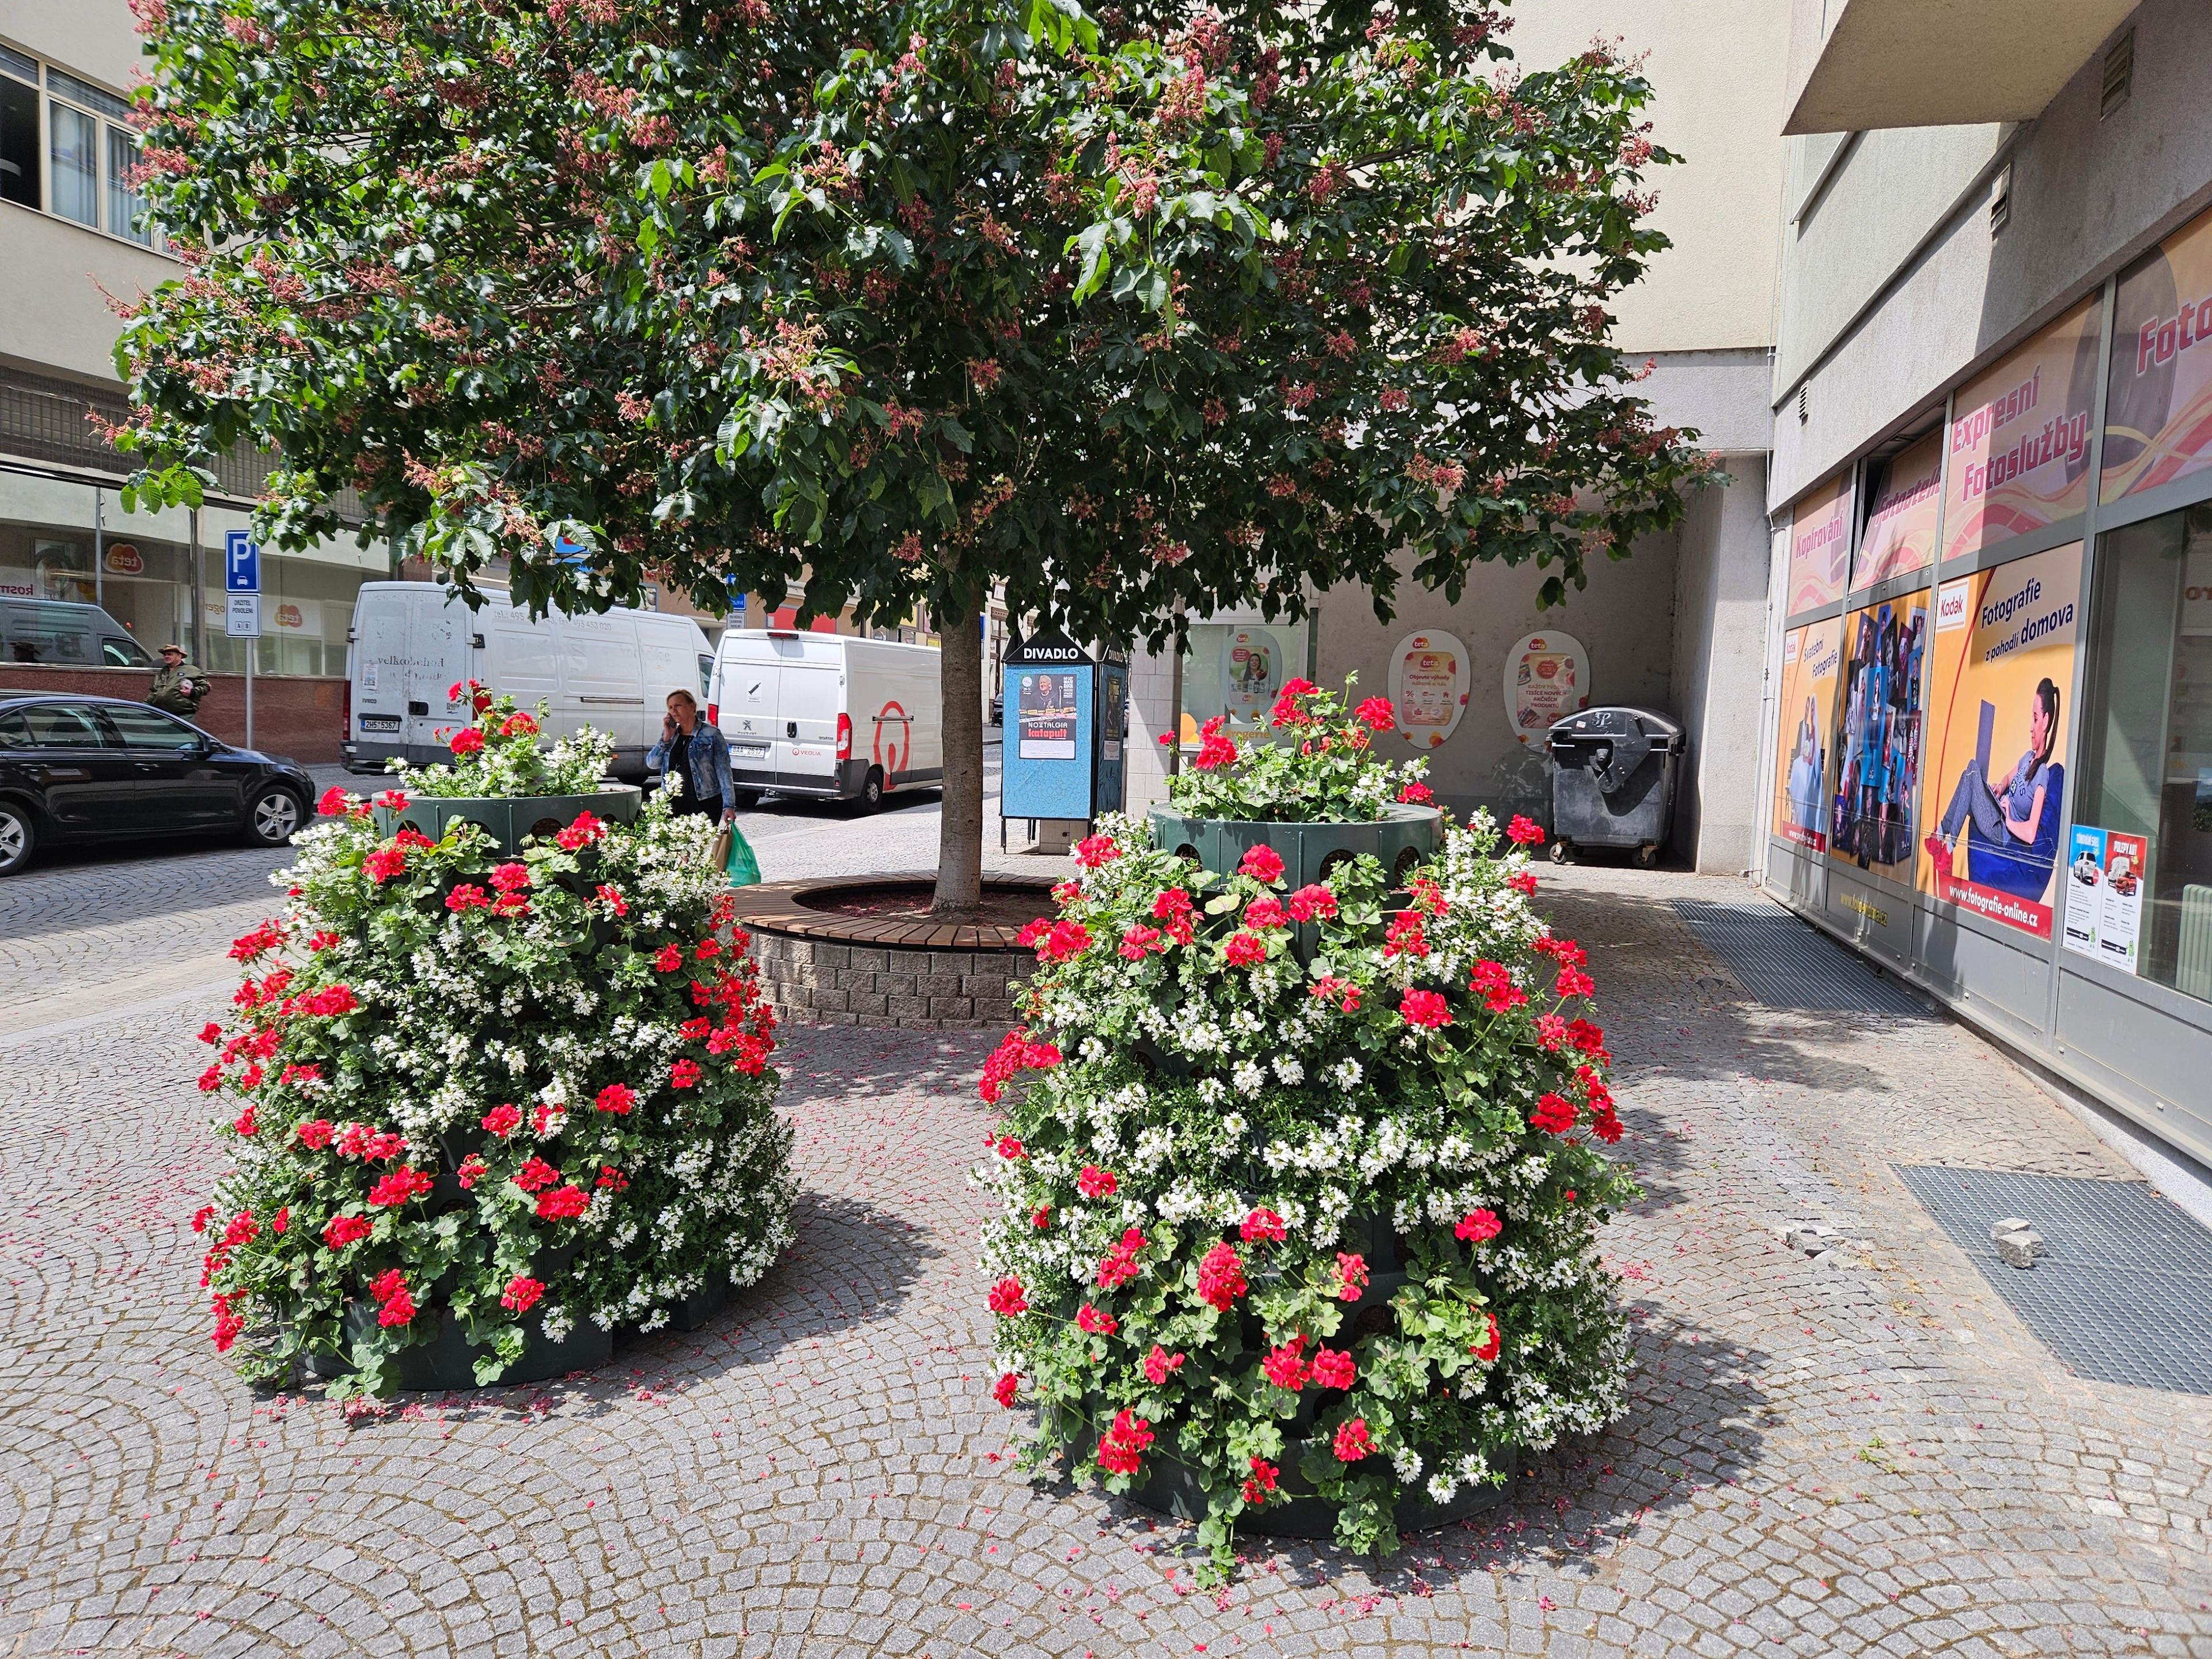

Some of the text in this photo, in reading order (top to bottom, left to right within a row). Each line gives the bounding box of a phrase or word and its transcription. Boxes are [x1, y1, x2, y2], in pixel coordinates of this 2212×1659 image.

[1952, 365, 2041, 454] Expresní
[1963, 414, 2086, 501] Fotoslužby
[1796, 508, 1843, 559] Kopírování
[233, 539, 251, 573] P
[1941, 594, 1963, 618] Kodak
[1981, 578, 2041, 629] Fotografie
[1804, 633, 1824, 662] Svatební
[1986, 603, 2074, 662] z pohodlí domova
[1024, 647, 1078, 660] DIVADLO
[1108, 649, 1123, 663] DIVADLO
[1812, 649, 1838, 679] Fotografie
[381, 721, 396, 729] 5367
[1028, 729, 1067, 739] katapult
[1949, 885, 2039, 927] www.fotografie-online.cz
